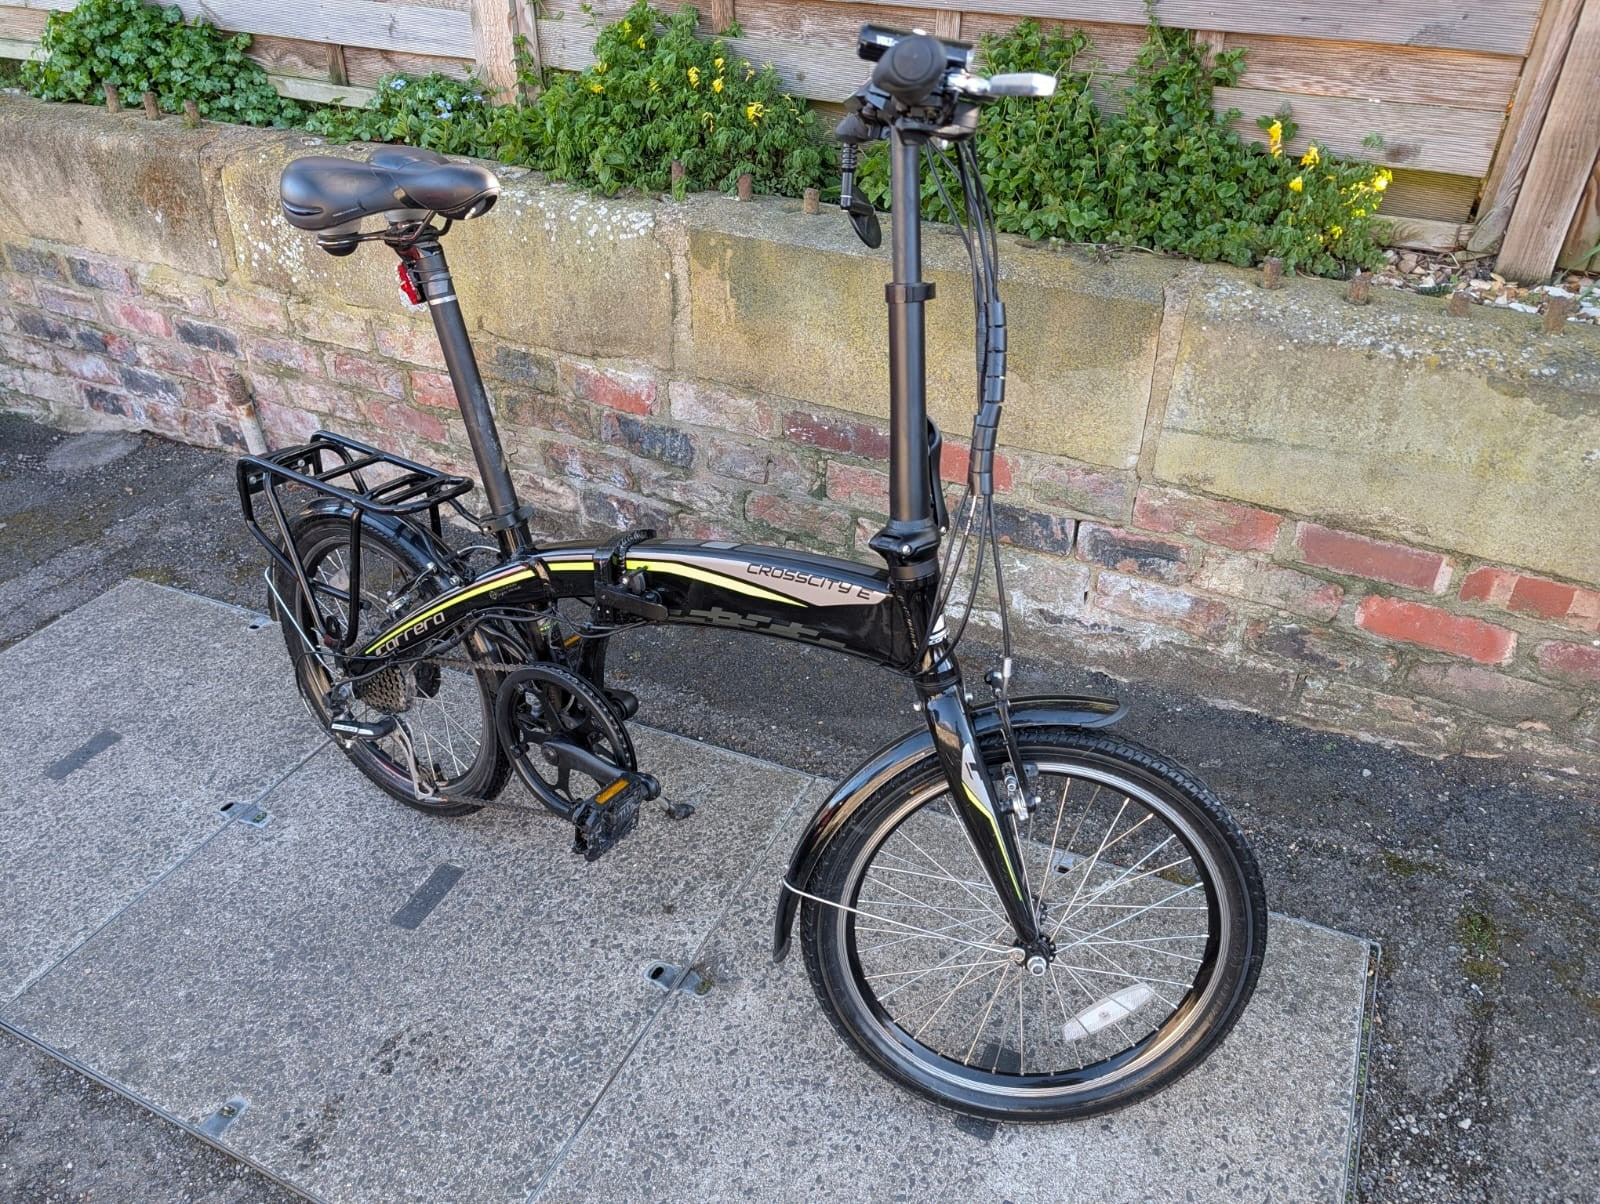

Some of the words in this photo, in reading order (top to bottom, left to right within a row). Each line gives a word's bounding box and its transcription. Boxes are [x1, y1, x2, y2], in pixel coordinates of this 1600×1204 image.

[746, 563, 852, 594] CROSSCITY
[857, 586, 873, 600] E
[375, 611, 445, 657] carrera
